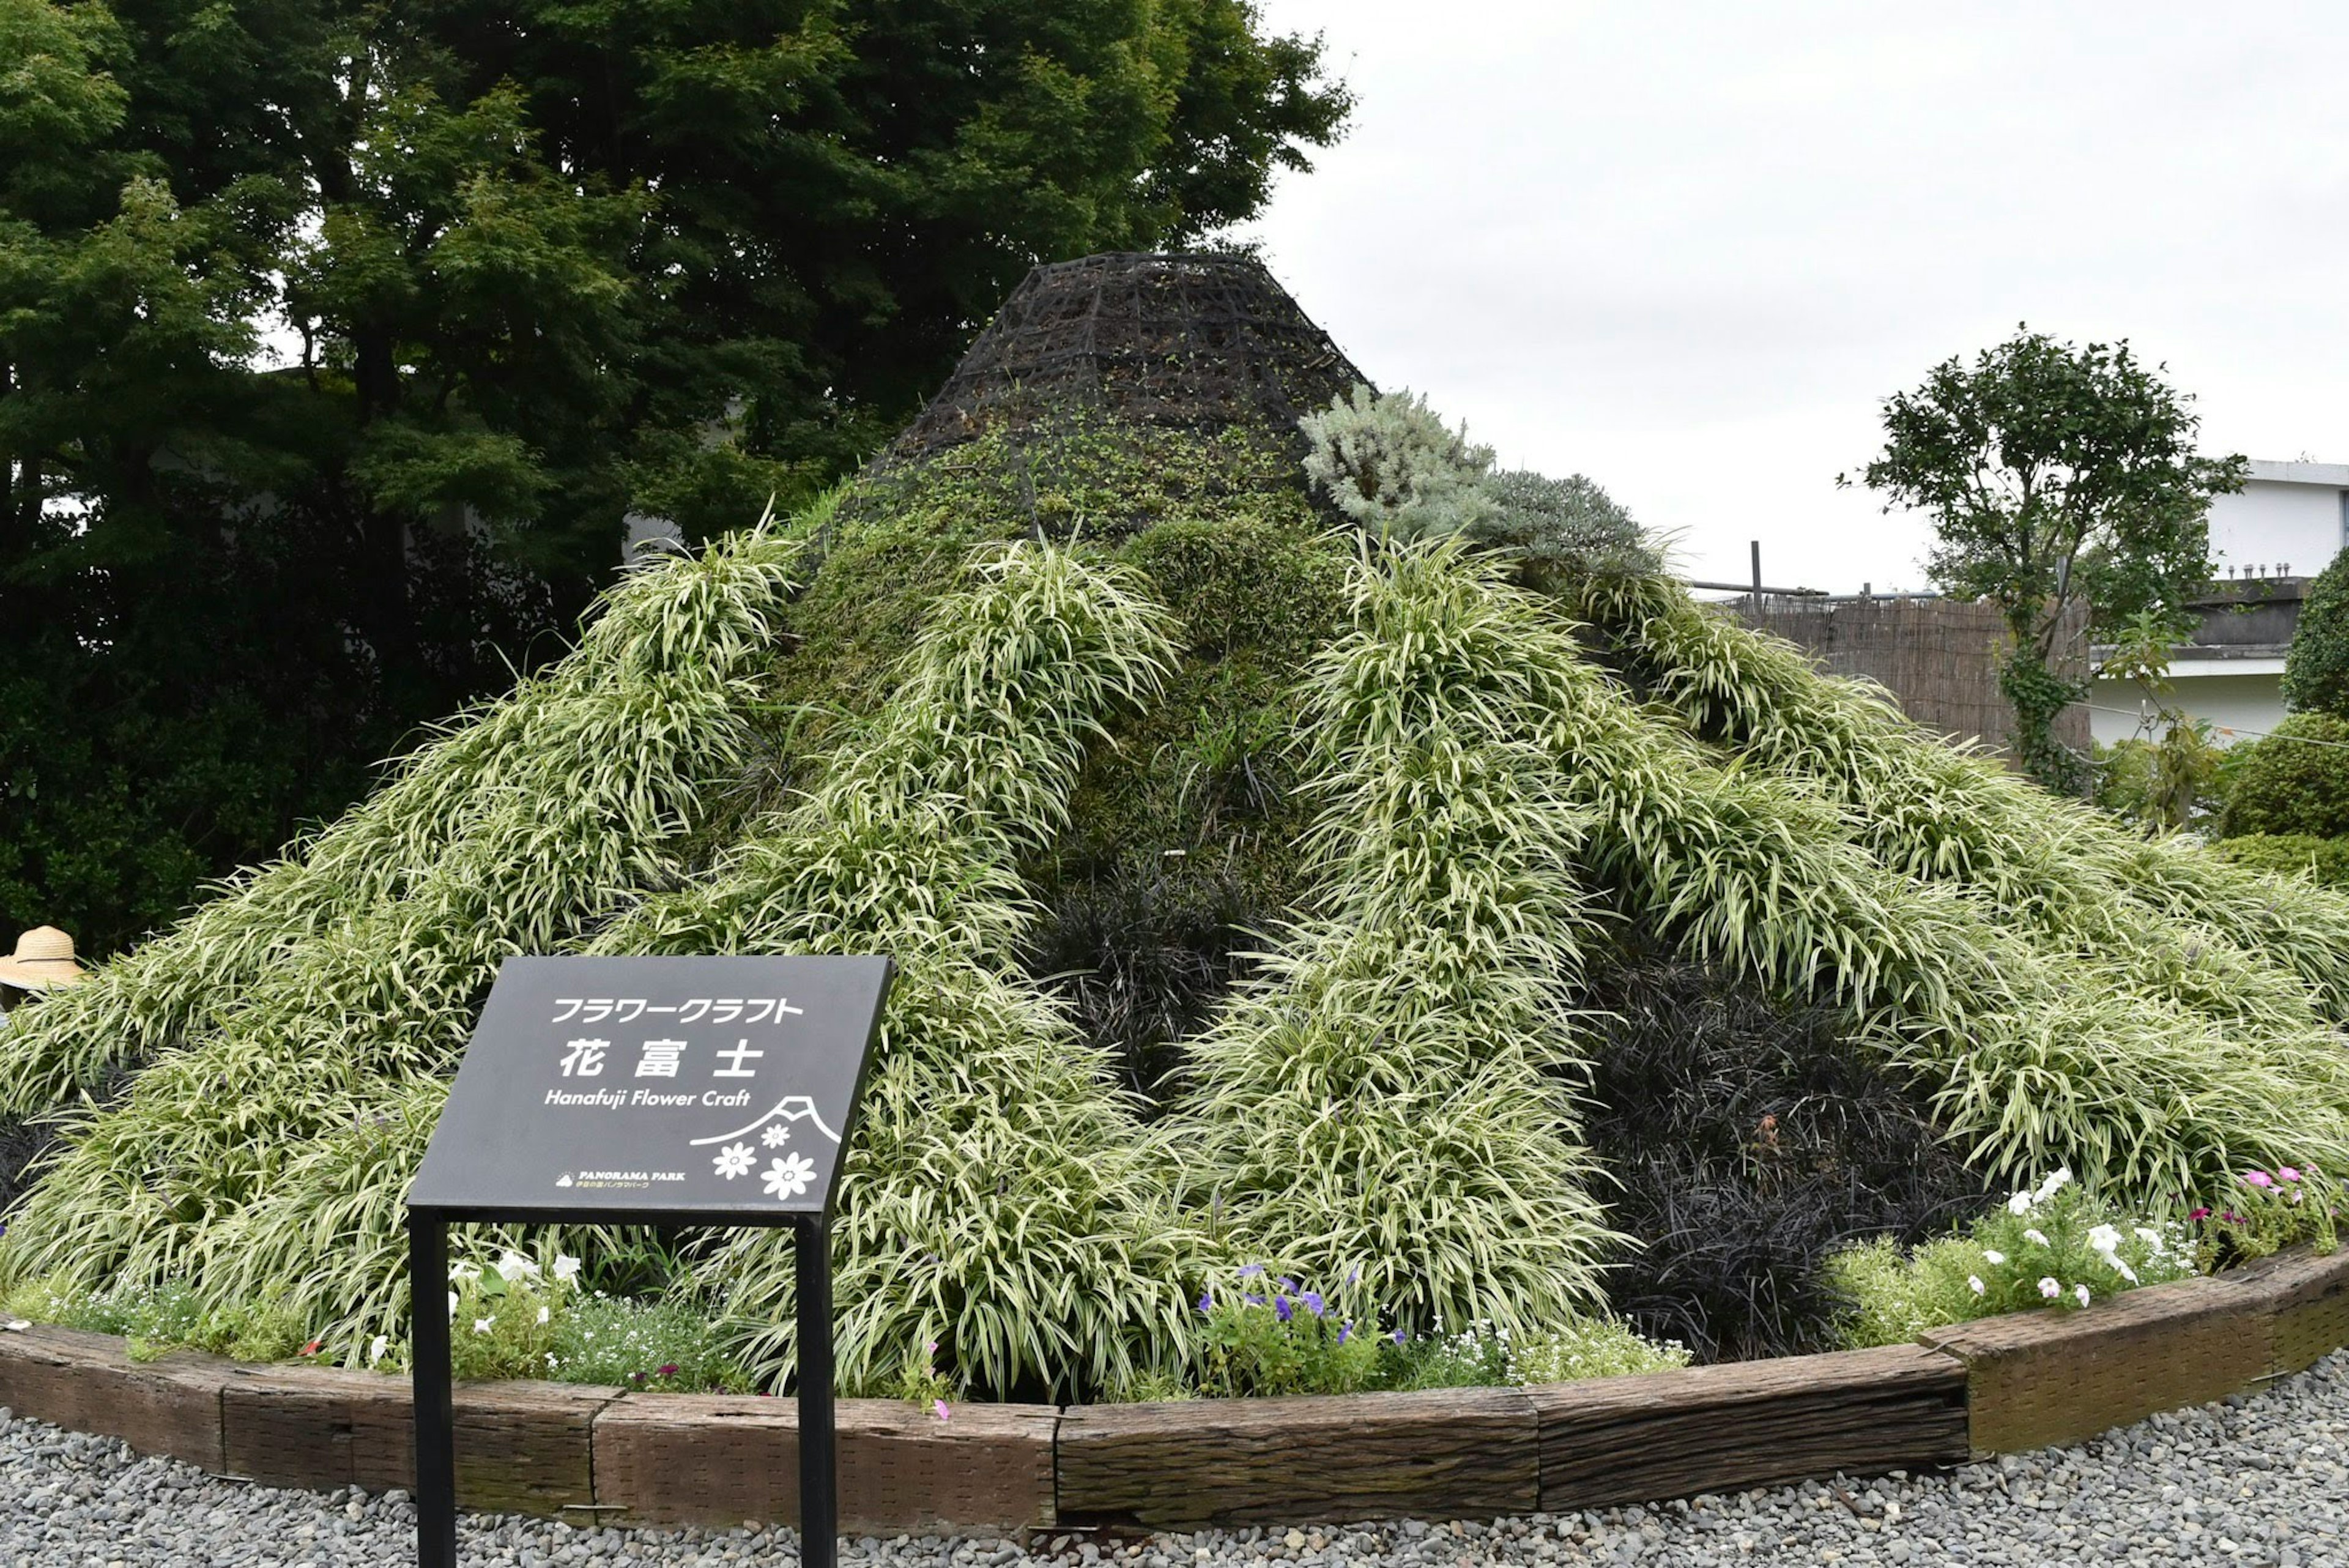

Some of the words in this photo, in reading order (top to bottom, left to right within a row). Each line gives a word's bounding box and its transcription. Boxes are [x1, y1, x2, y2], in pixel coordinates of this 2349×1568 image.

[552, 998, 803, 1024] フラワークラフト
[560, 1039, 763, 1077] 花富士
[544, 1088, 626, 1110] Hanafuji
[631, 1088, 696, 1106] Flower
[702, 1089, 751, 1106] Craft
[579, 1171, 648, 1181] PANORAMA
[651, 1172, 686, 1181] PARK
